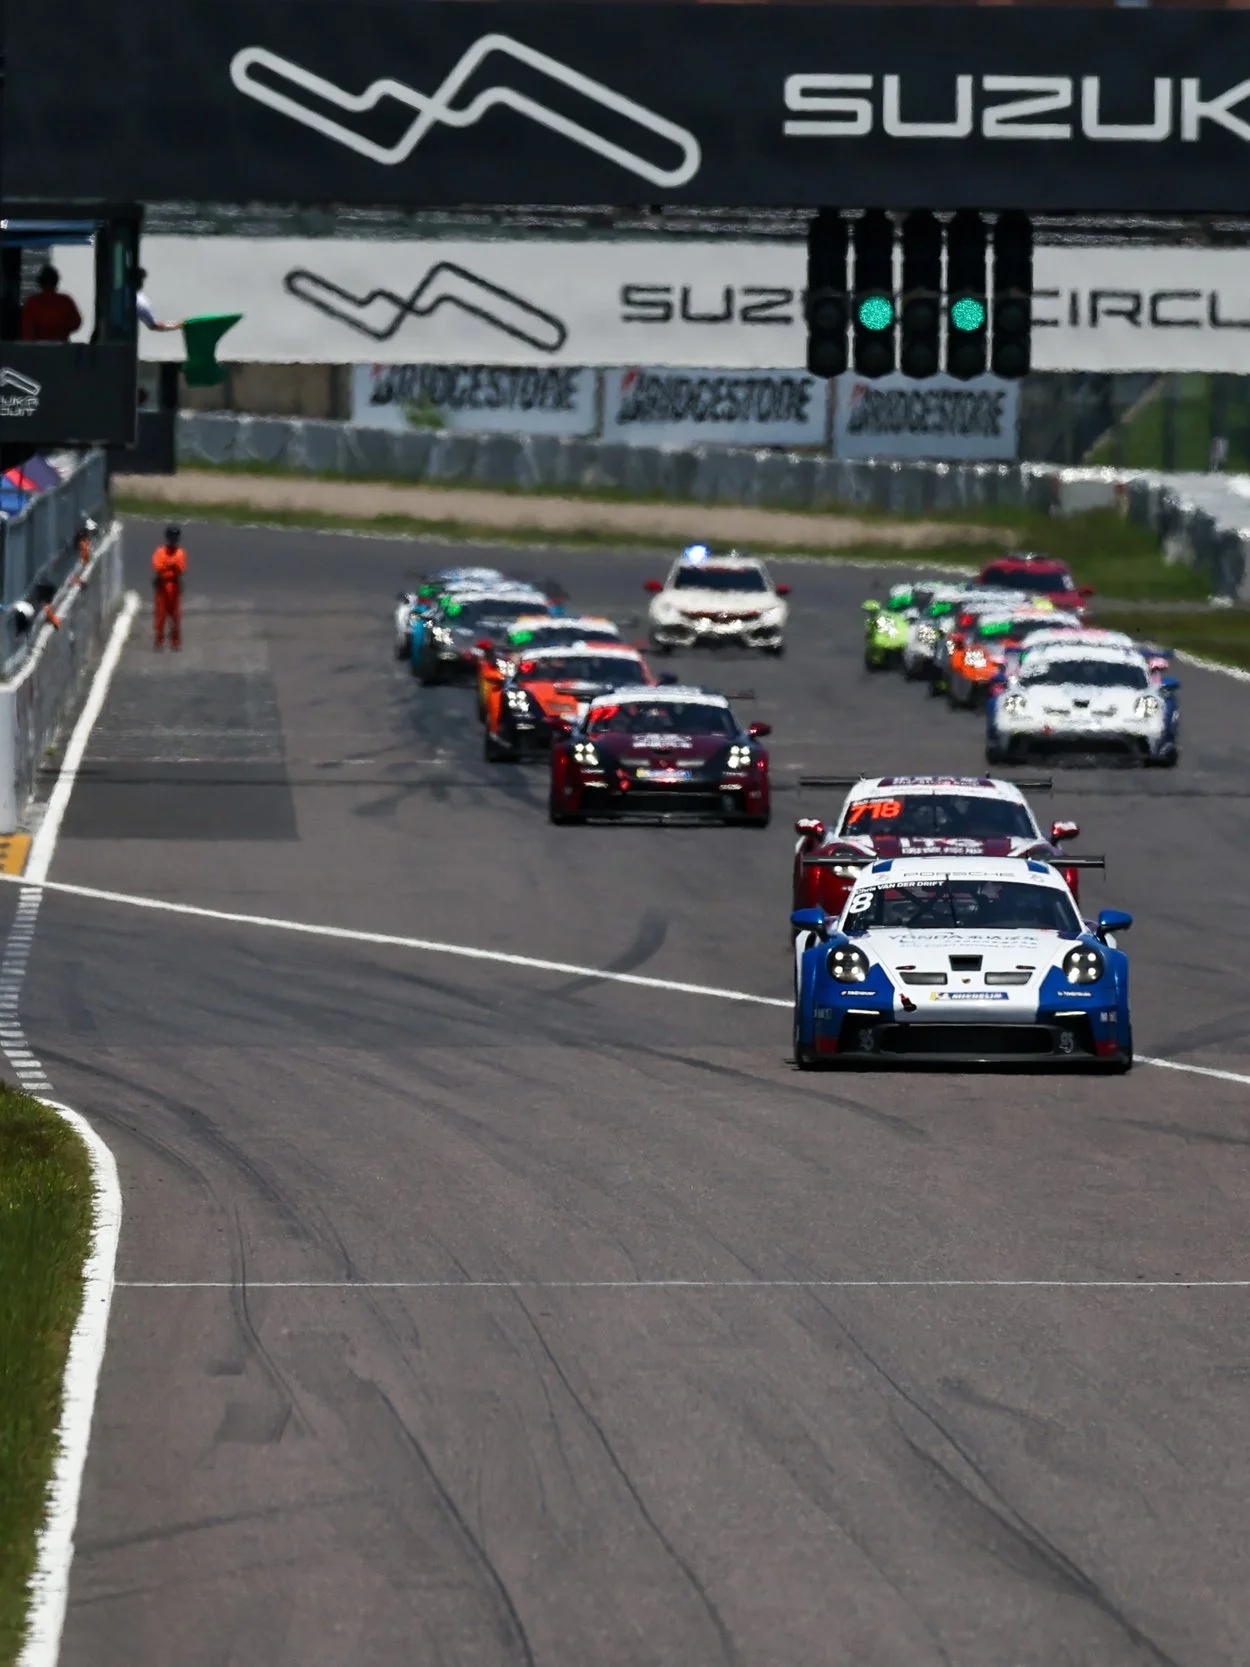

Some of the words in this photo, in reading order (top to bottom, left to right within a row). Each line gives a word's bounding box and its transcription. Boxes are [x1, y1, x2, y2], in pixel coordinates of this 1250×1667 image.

[848, 800, 902, 825] 718
[877, 882, 896, 890] VAN
[849, 892, 874, 914] 8
